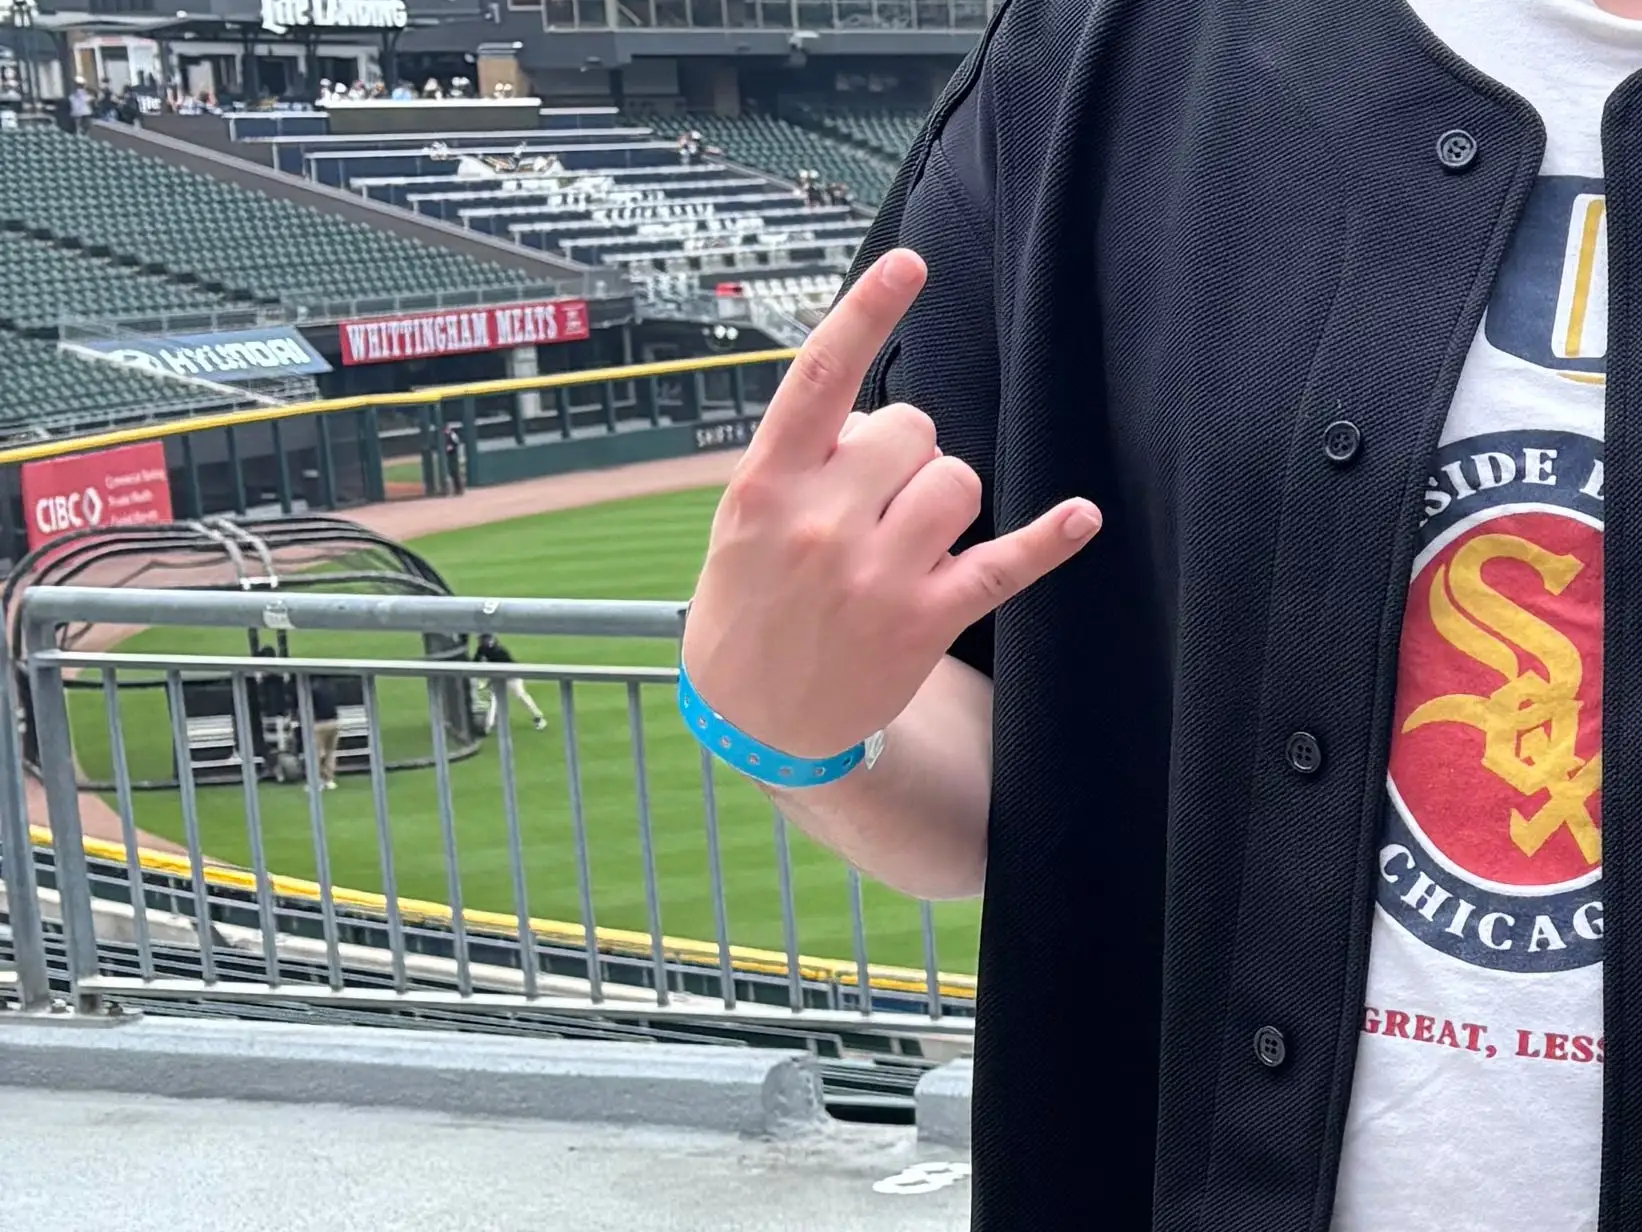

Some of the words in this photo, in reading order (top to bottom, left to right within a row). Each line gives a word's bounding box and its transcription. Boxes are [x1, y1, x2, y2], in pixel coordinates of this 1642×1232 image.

[159, 334, 310, 375] HYUNDAI
[346, 310, 490, 362] WHITTINGHAM
[495, 303, 557, 344] MEATS
[36, 491, 83, 534] CIBC
[1360, 1006, 1498, 1058] GREAT,
